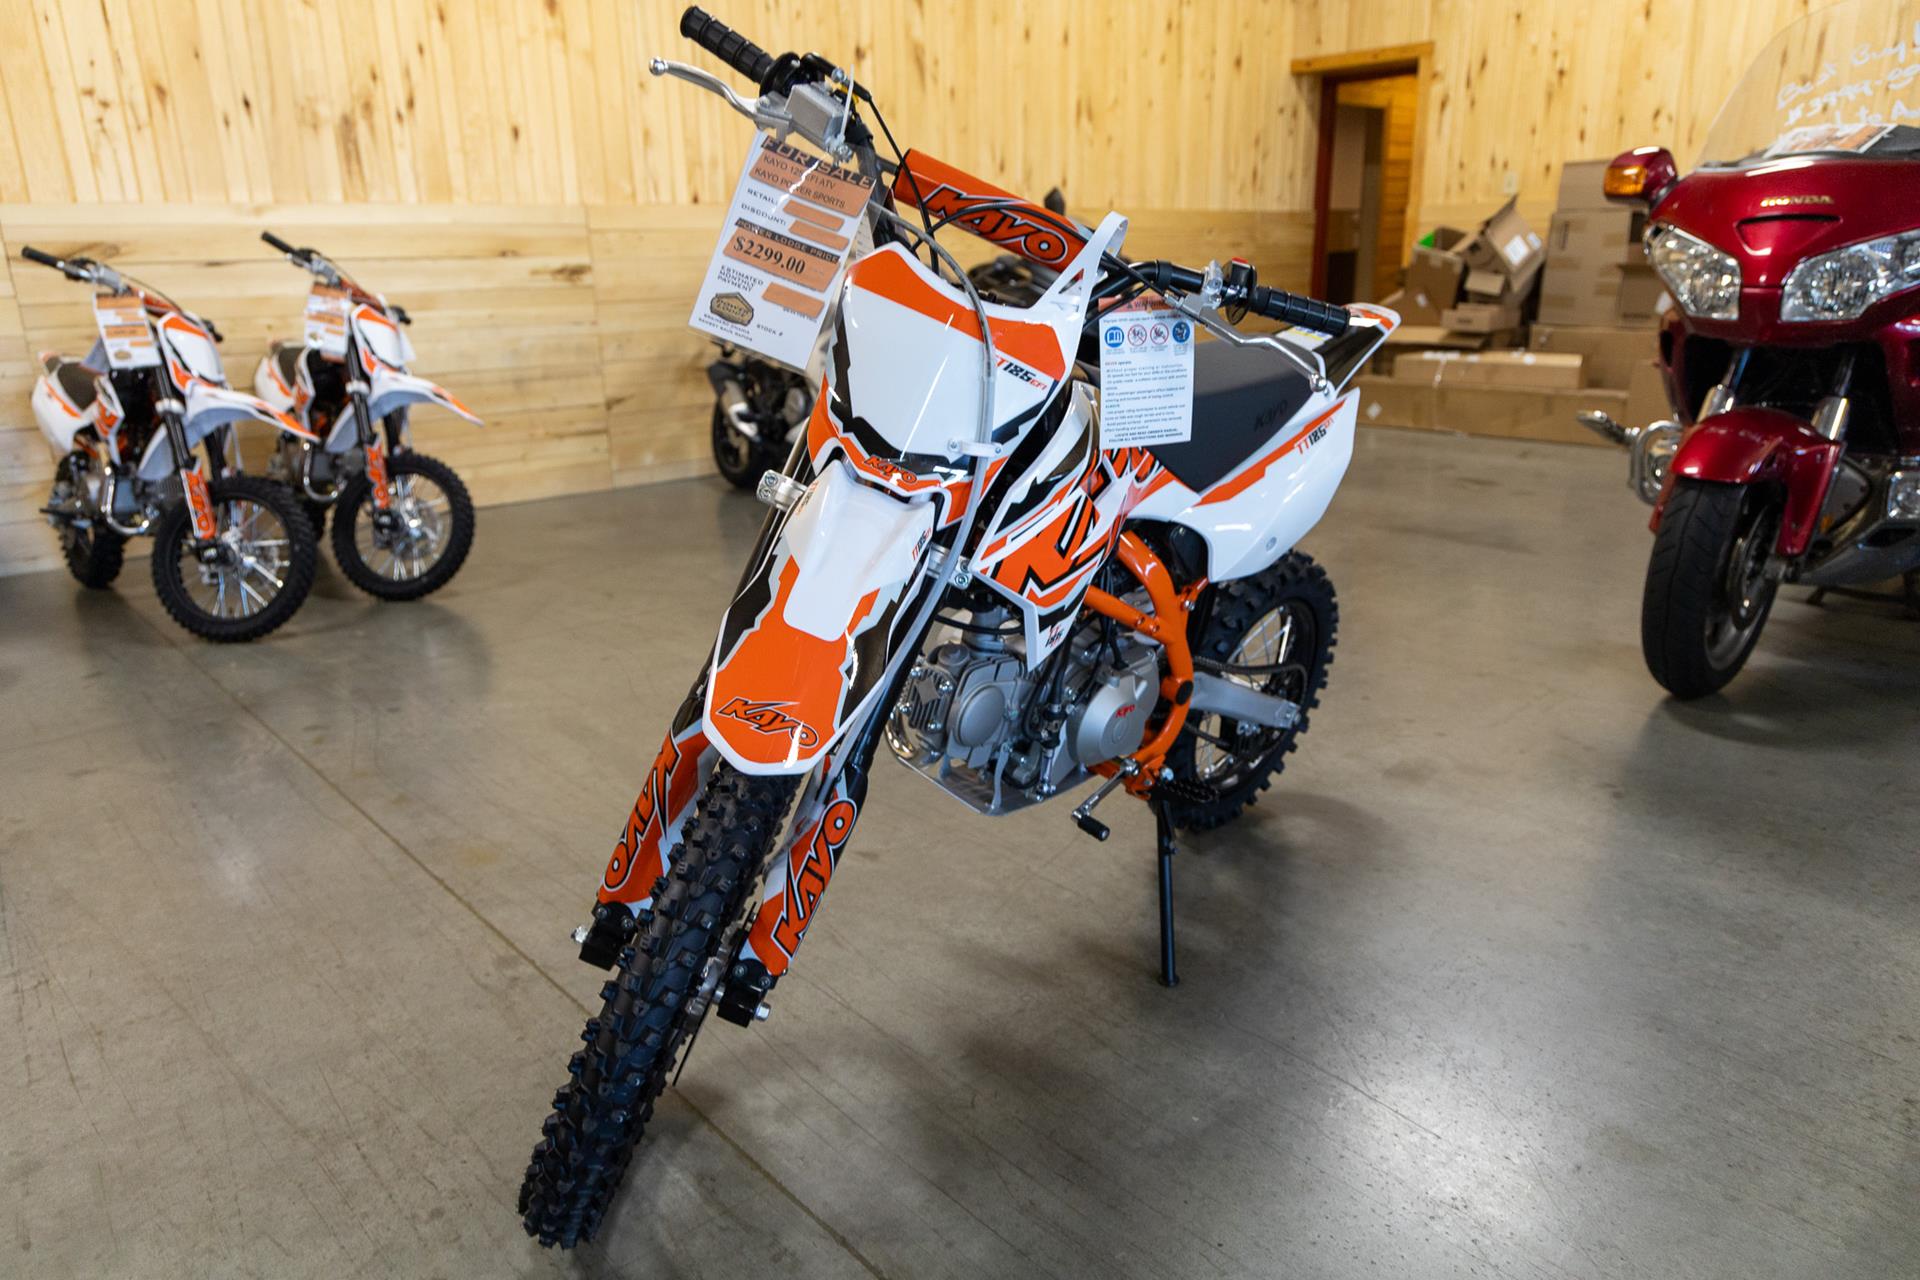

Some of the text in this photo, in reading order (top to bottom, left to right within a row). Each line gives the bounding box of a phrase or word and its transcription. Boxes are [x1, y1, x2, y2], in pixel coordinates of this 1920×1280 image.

[763, 135, 871, 189] FOR SALE
[764, 155, 788, 171] KAYO
[754, 167, 779, 183] KAYO
[813, 189, 846, 208] SPORTS
[733, 235, 806, 275] $2299.00
[737, 220, 839, 263] POWER LODGE PRICE
[717, 697, 819, 748] KAYO
[771, 798, 858, 961] KAYO
